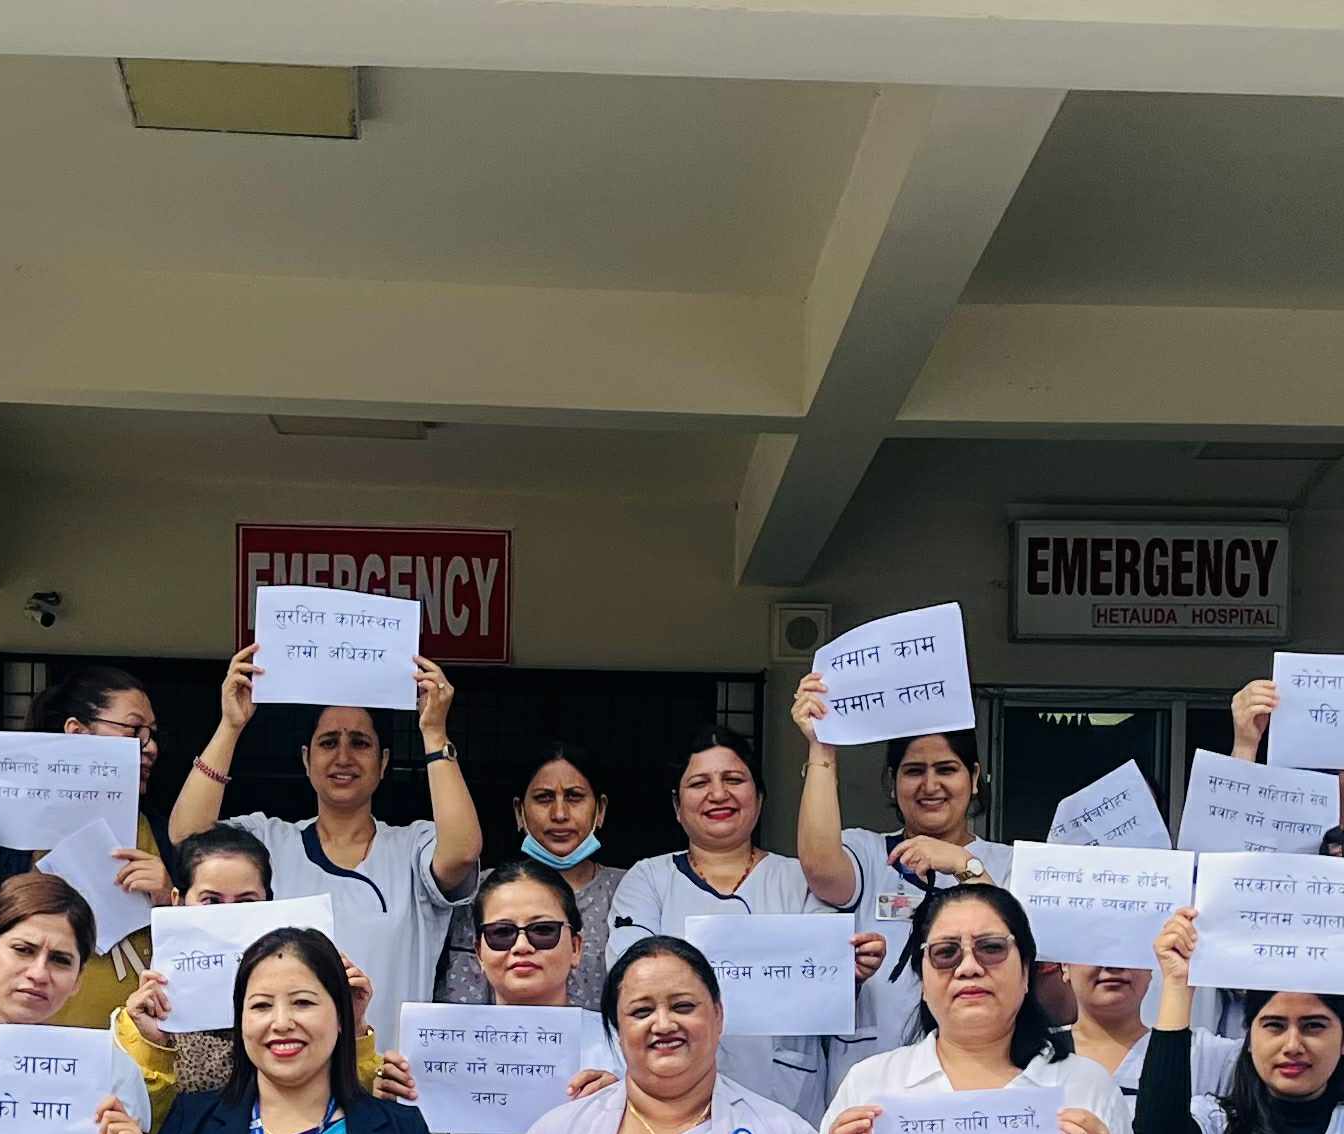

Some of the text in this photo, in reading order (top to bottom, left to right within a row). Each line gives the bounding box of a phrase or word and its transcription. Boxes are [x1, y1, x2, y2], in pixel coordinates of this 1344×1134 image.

[1026, 536, 1280, 598] EMERGENCY
[273, 604, 401, 631] सुरक्षित कार्यस्थल
[1096, 607, 1276, 625] HETAUDA HOSPITAL
[327, 641, 387, 663] अधिकार
[831, 635, 937, 671] समान काम
[829, 690, 885, 717] समान
[1307, 702, 1341, 728] पछि
[1231, 873, 1299, 894] सरकारले
[1239, 910, 1295, 930] न्यूनतम
[171, 949, 227, 973] जोखिम
[1252, 943, 1329, 961] कायम गर
[711, 960, 755, 982] ोखिम
[761, 965, 793, 980] भत्ता
[417, 1024, 564, 1048] मुस्कान सहितको सेवा
[13, 1055, 79, 1076] आवाज
[423, 1060, 459, 1074] प्रवाह
[495, 1062, 557, 1078] वातावरण
[30, 1101, 72, 1121] माग
[897, 1115, 946, 1134] देशका
[952, 1110, 990, 1131] लागि
